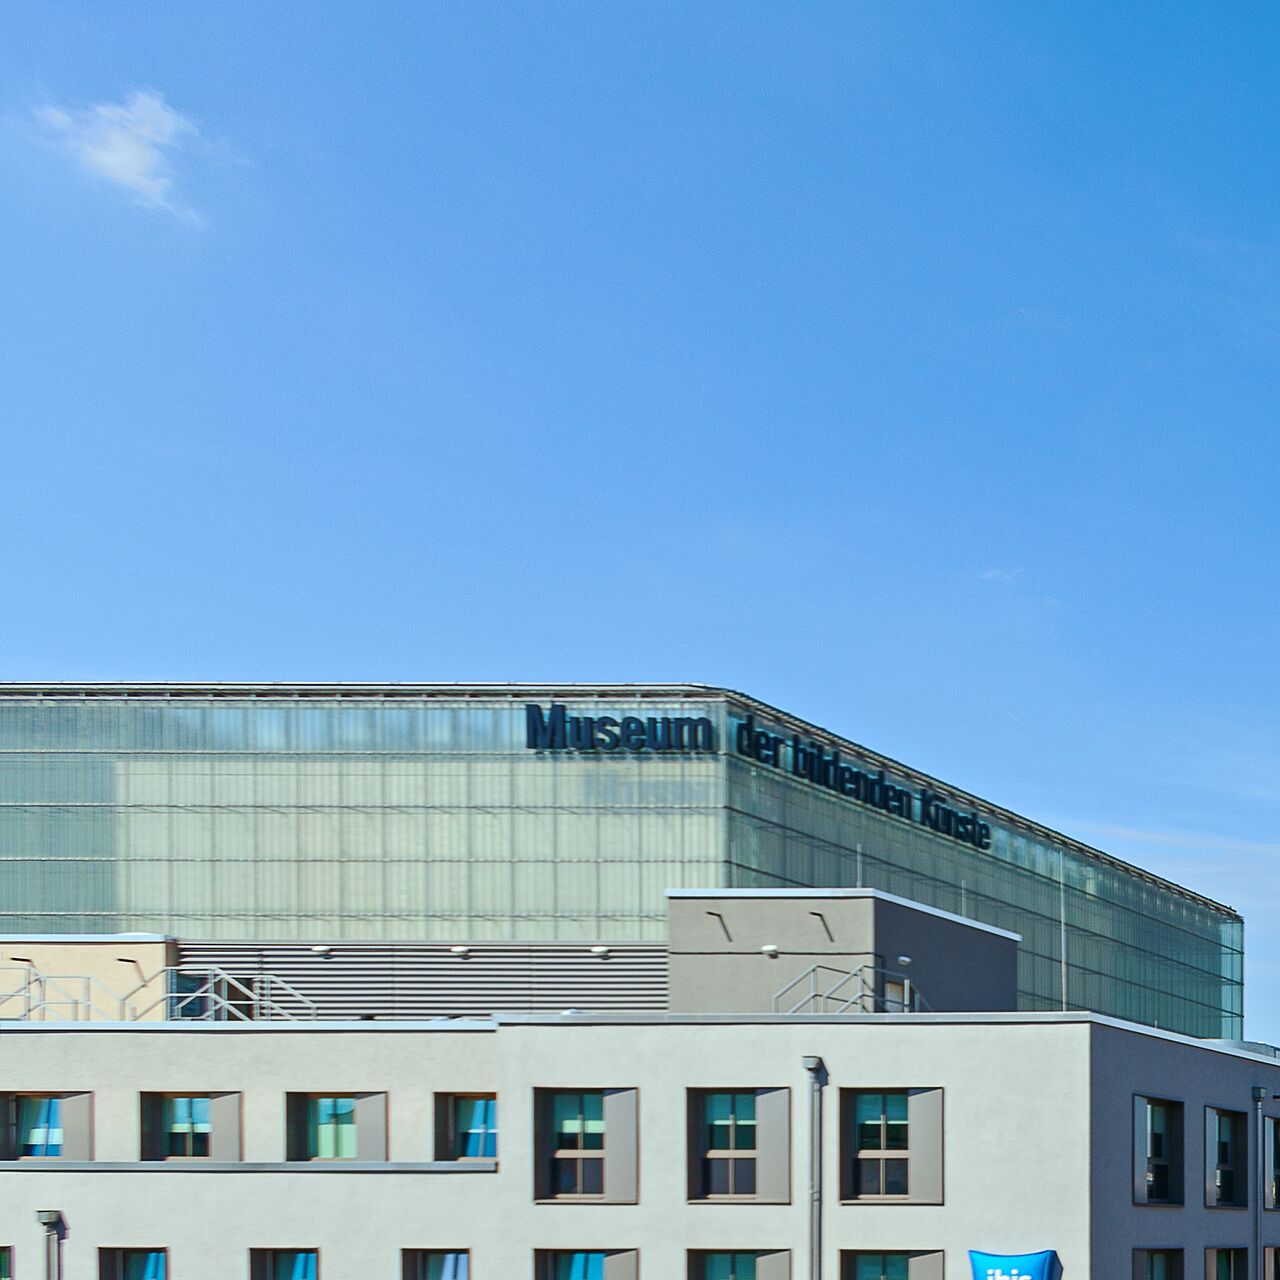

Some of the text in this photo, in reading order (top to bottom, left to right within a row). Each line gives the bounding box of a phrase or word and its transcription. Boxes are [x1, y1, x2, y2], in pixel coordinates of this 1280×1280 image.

[526, 704, 992, 851] Museum der bildenden Künste
